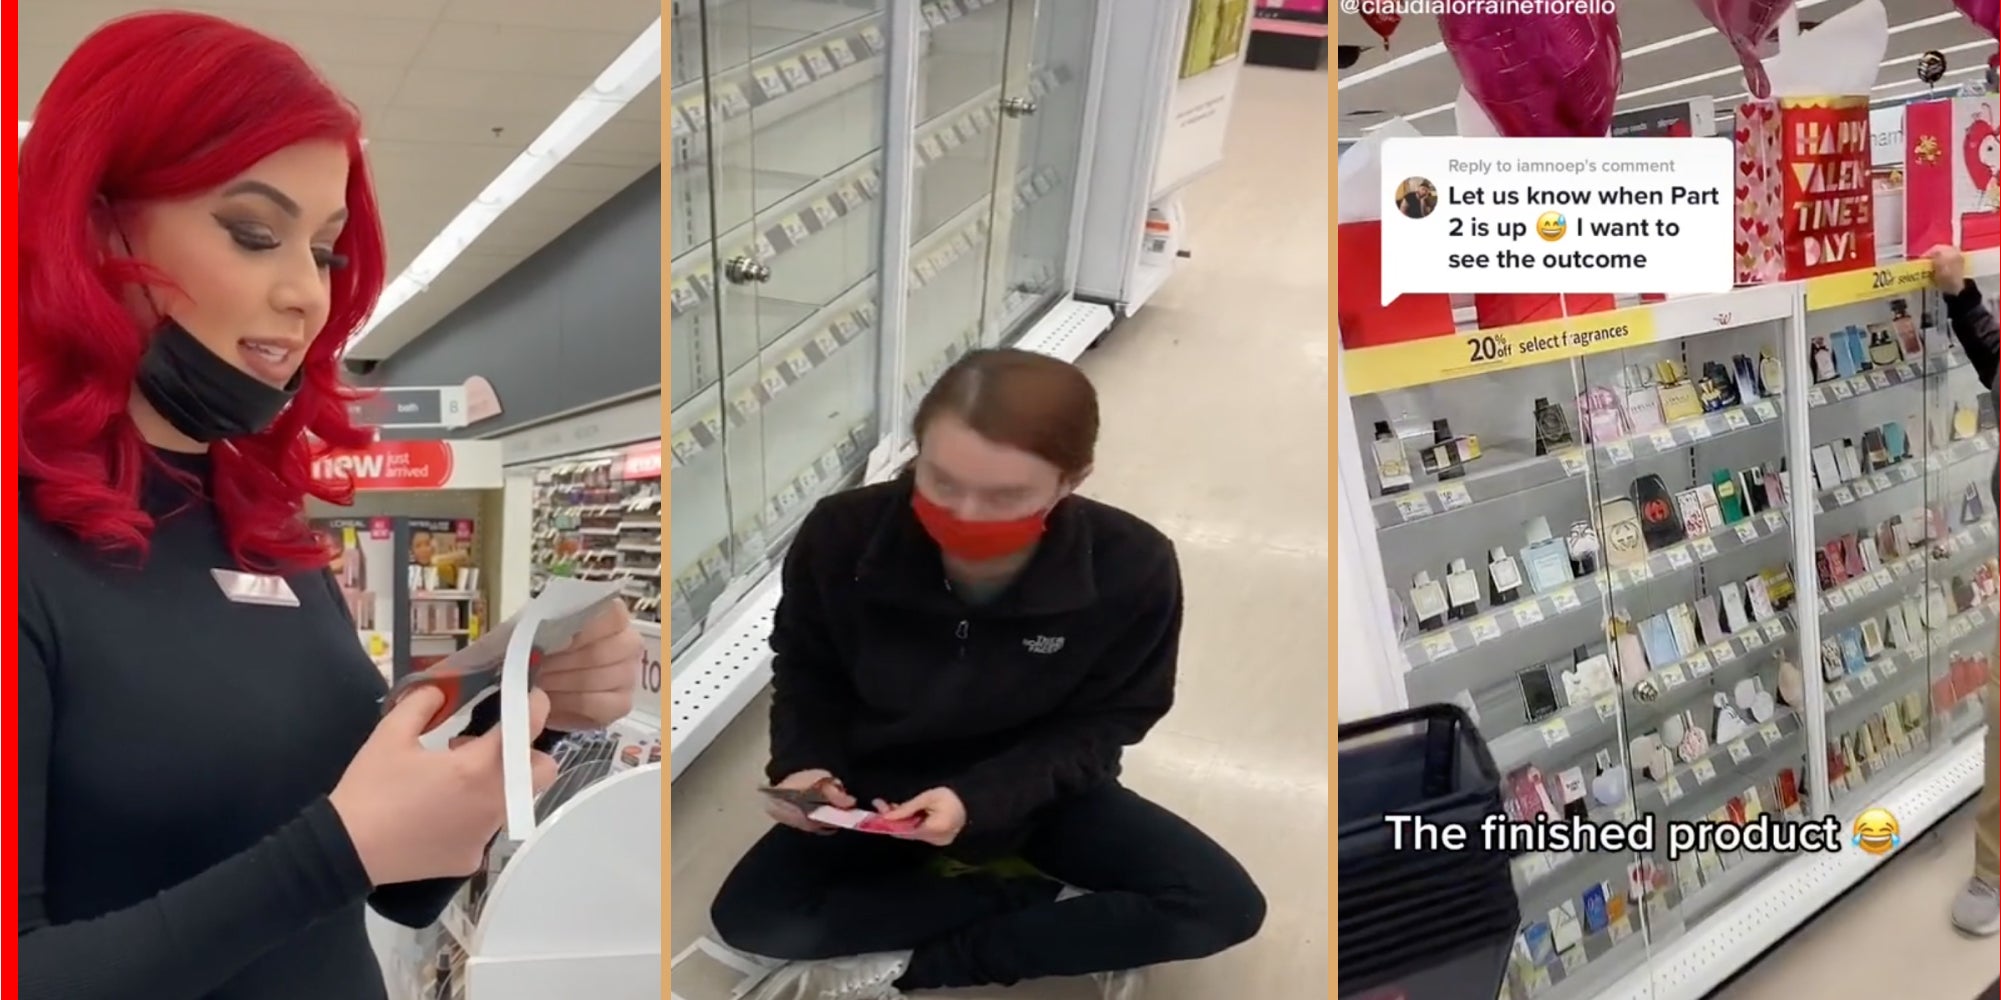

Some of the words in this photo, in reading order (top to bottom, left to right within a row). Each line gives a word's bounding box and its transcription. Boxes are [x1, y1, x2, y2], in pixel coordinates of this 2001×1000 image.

[1795, 119, 1868, 155] HAPPY
[1792, 195, 1870, 232] TINE'S
[1803, 231, 1857, 267] DAY!
[1497, 344, 1513, 359] off
[1518, 335, 1560, 354] select
[311, 454, 385, 479] new
[385, 463, 430, 478] arrived
[386, 452, 410, 466] just
